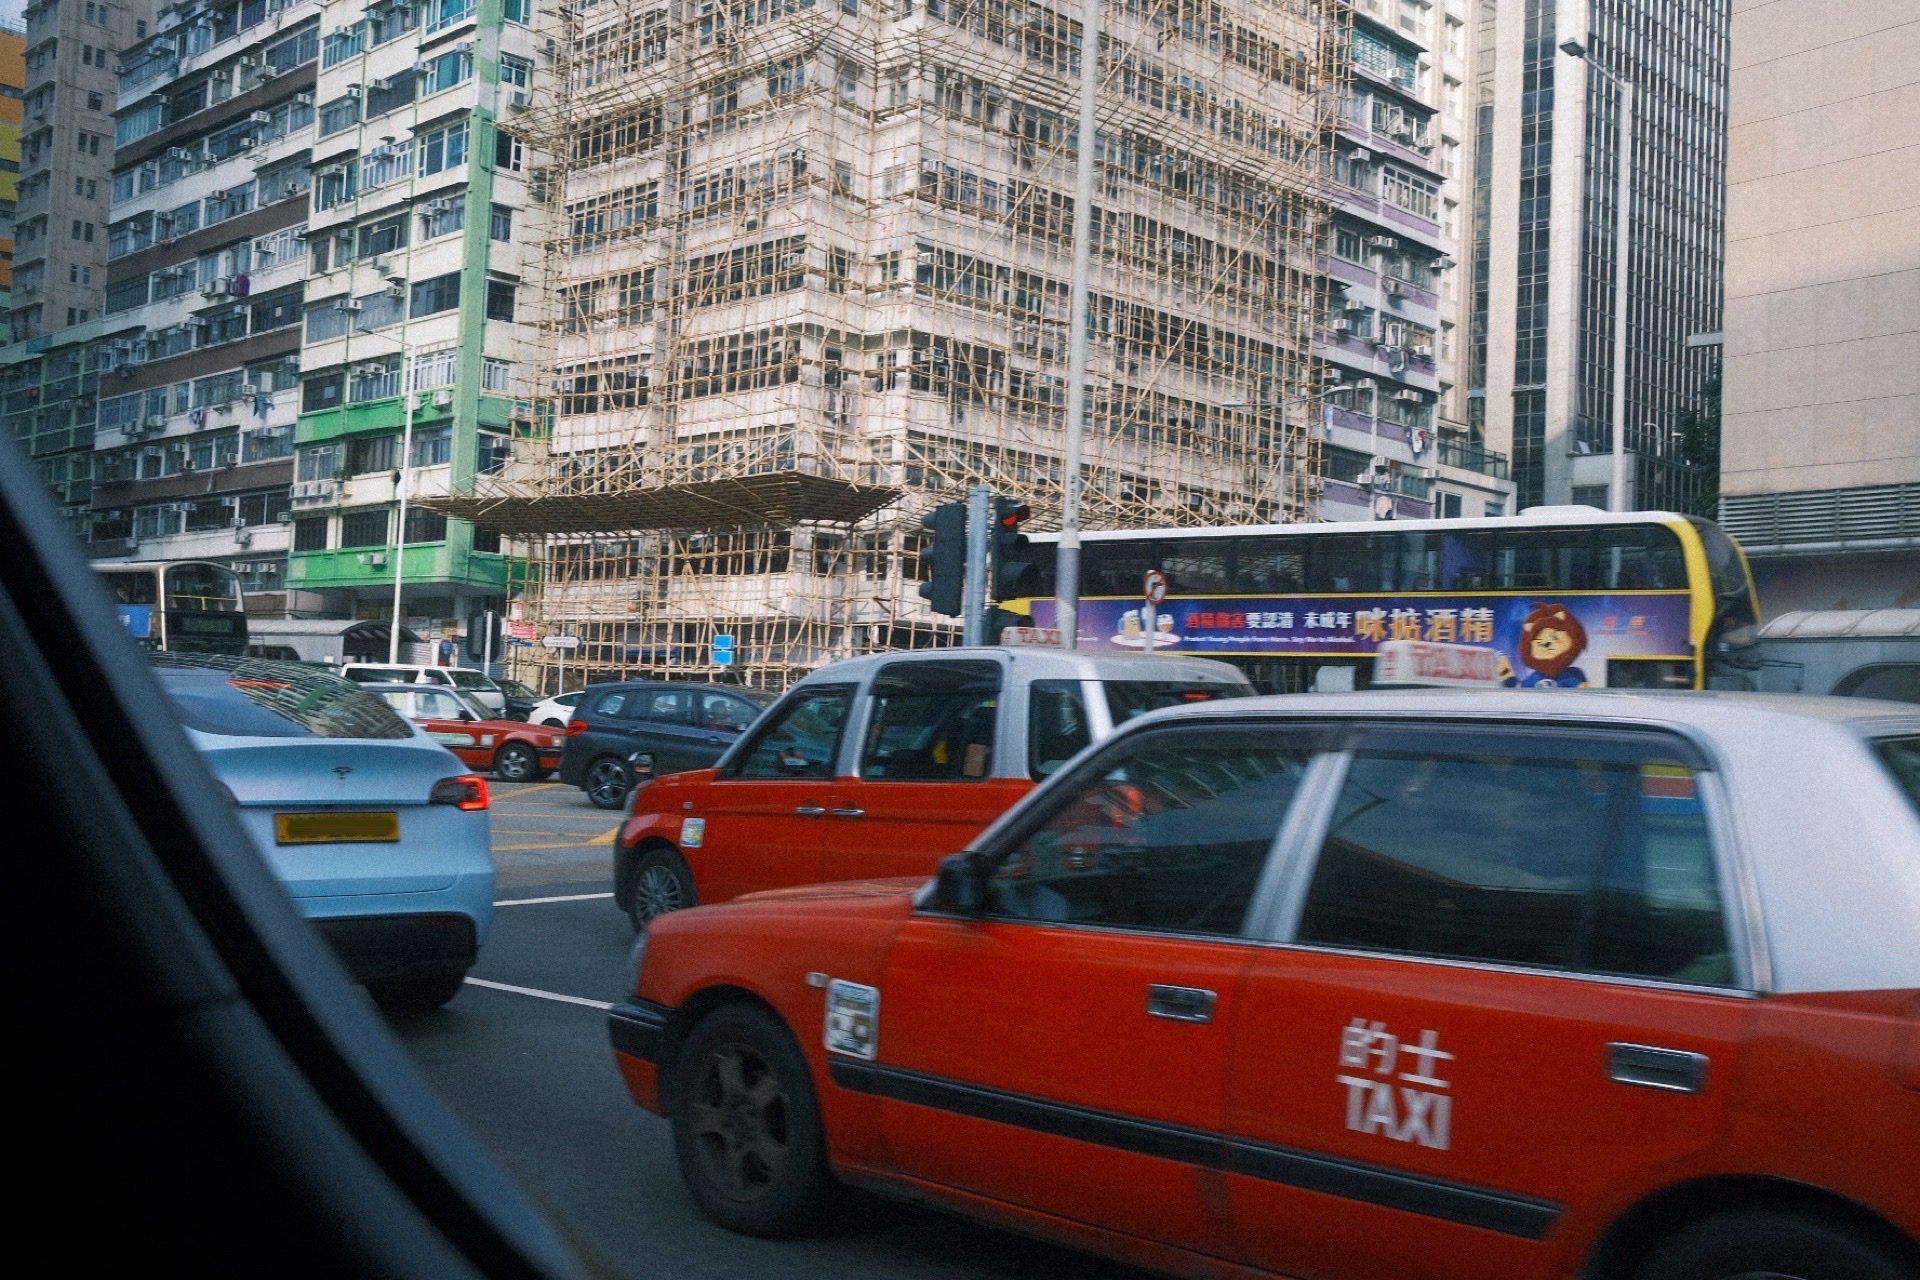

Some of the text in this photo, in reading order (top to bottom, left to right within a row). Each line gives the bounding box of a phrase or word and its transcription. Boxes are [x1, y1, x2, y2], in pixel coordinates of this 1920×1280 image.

[1303, 611, 1352, 629] 未成年
[1354, 607, 1494, 643] 咪掂酒精
[1409, 644, 1496, 681] TAXI
[1338, 1017, 1457, 1088] 的士
[1335, 1073, 1454, 1151] TAXI
